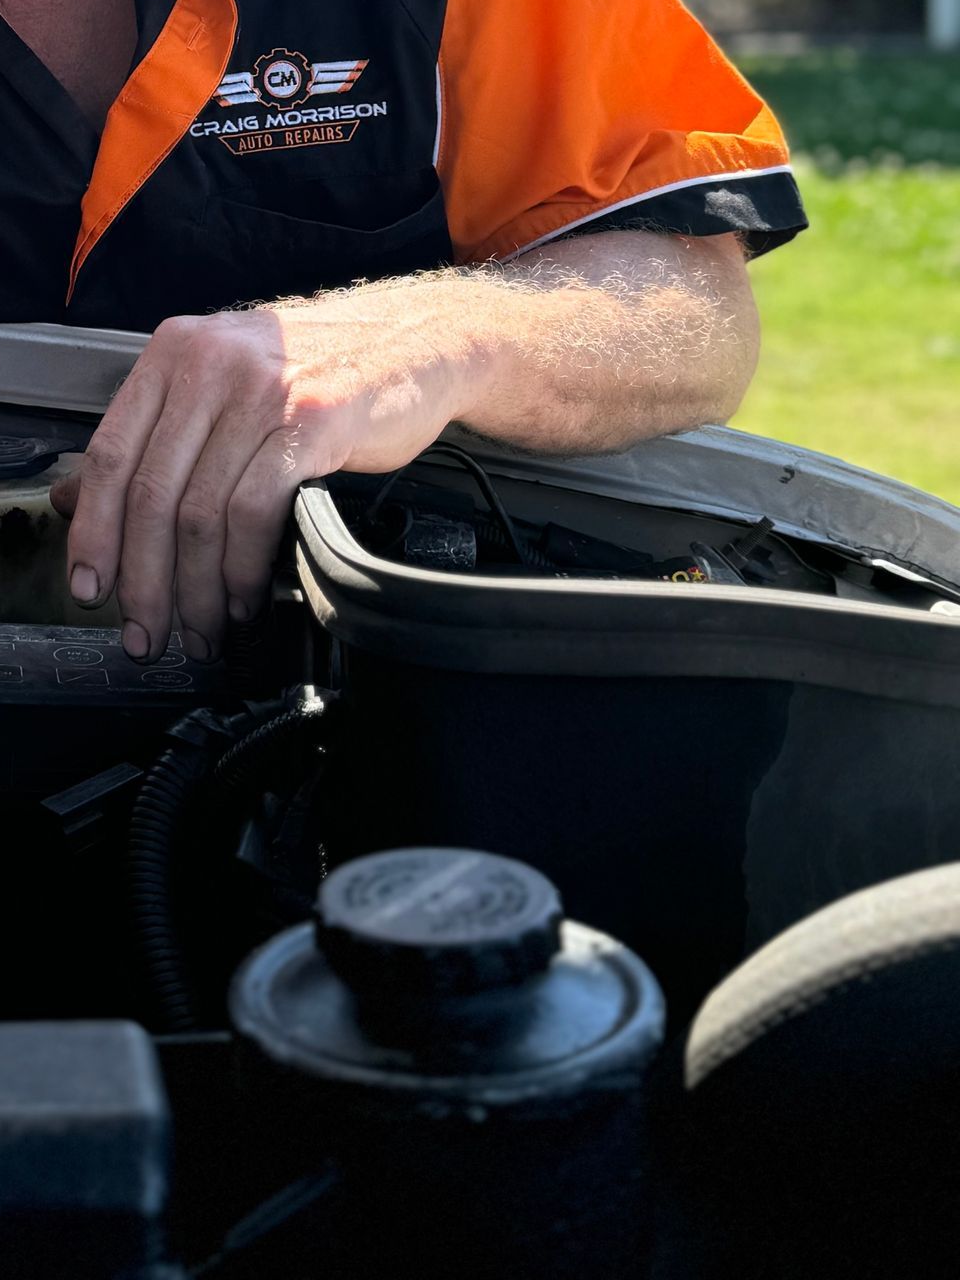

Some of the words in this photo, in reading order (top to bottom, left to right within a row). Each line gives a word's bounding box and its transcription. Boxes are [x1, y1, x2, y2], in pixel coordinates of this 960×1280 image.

[267, 72, 298, 88] CM
[190, 115, 259, 138] CRAIG
[265, 101, 388, 129] MORRISON
[238, 133, 274, 151] AUTO
[285, 126, 344, 146] REPAIRS
